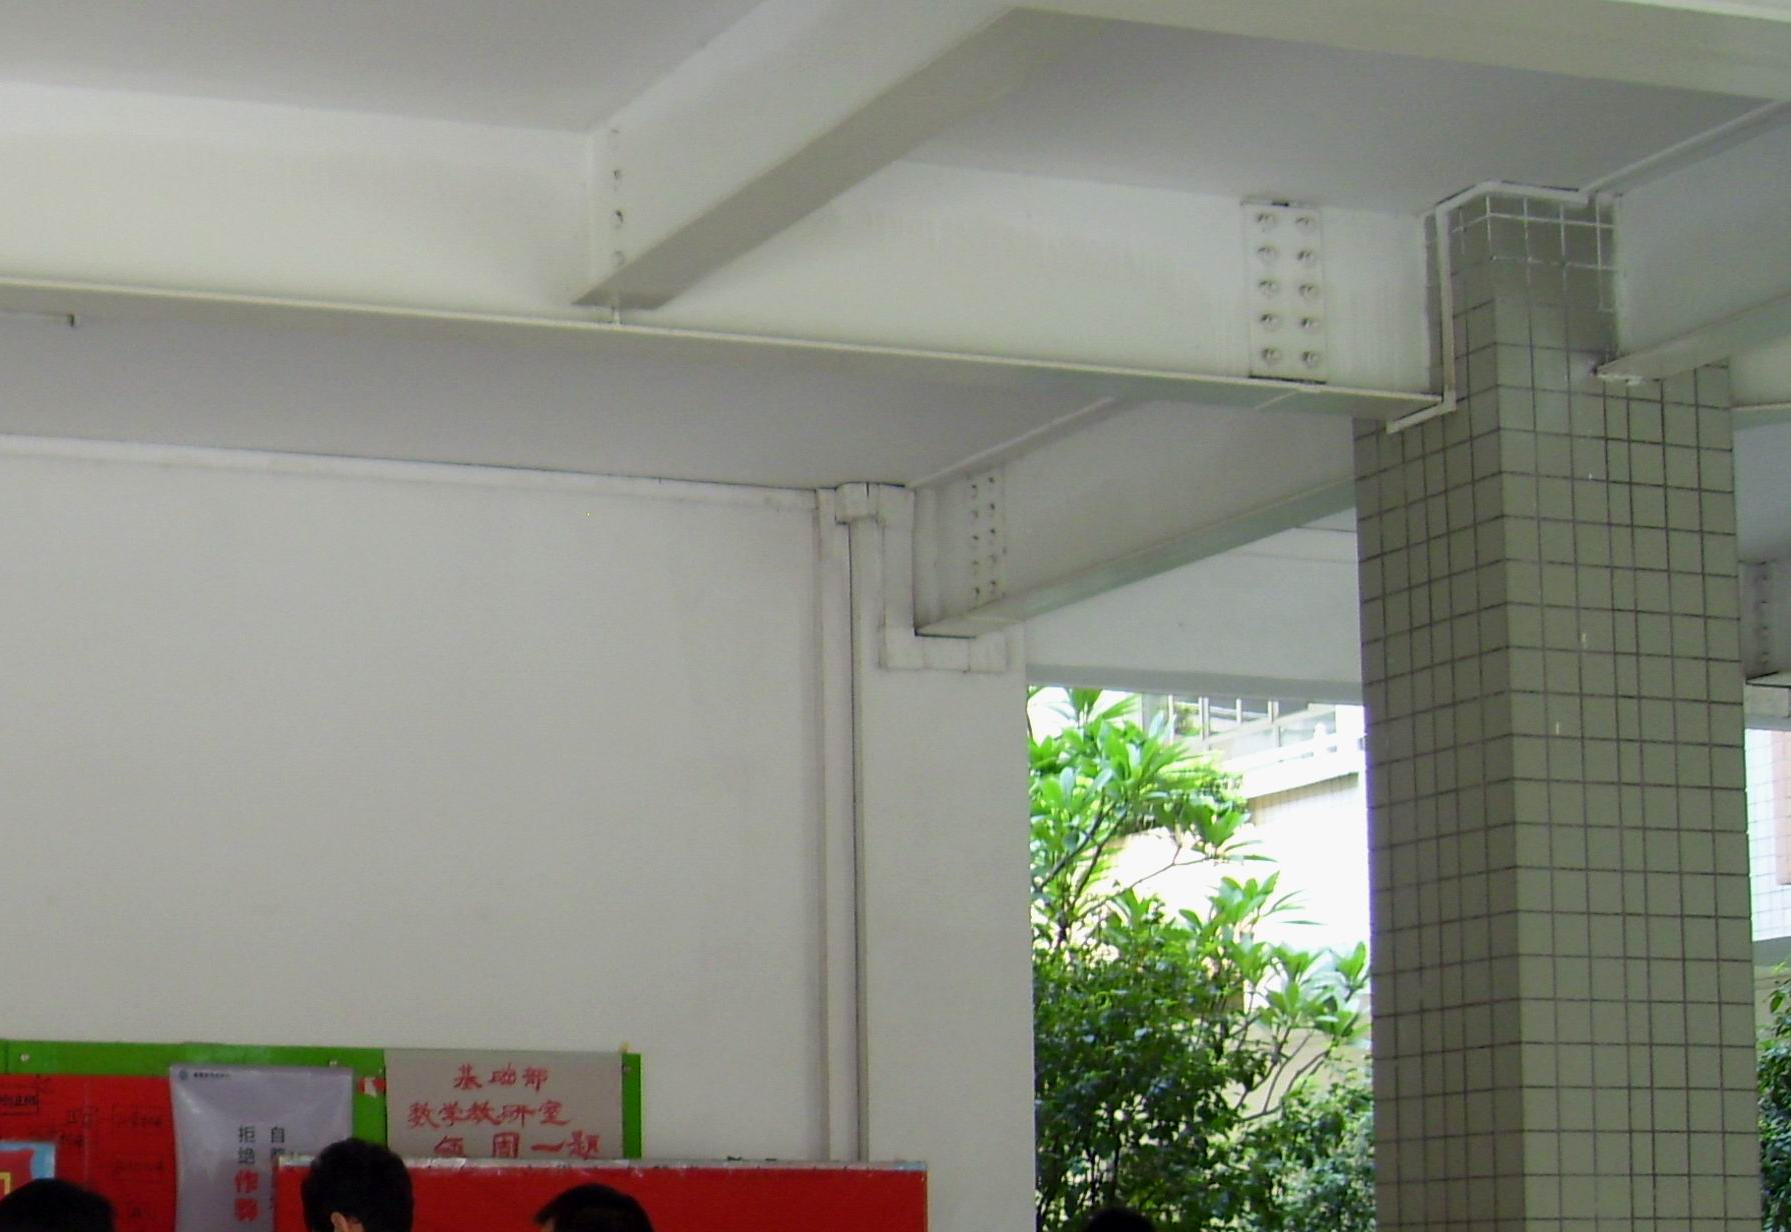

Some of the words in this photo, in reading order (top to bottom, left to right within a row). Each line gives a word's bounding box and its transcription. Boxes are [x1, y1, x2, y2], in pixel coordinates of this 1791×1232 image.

[454, 1063, 548, 1092] 基础部
[408, 1100, 571, 1130] 数学教研室
